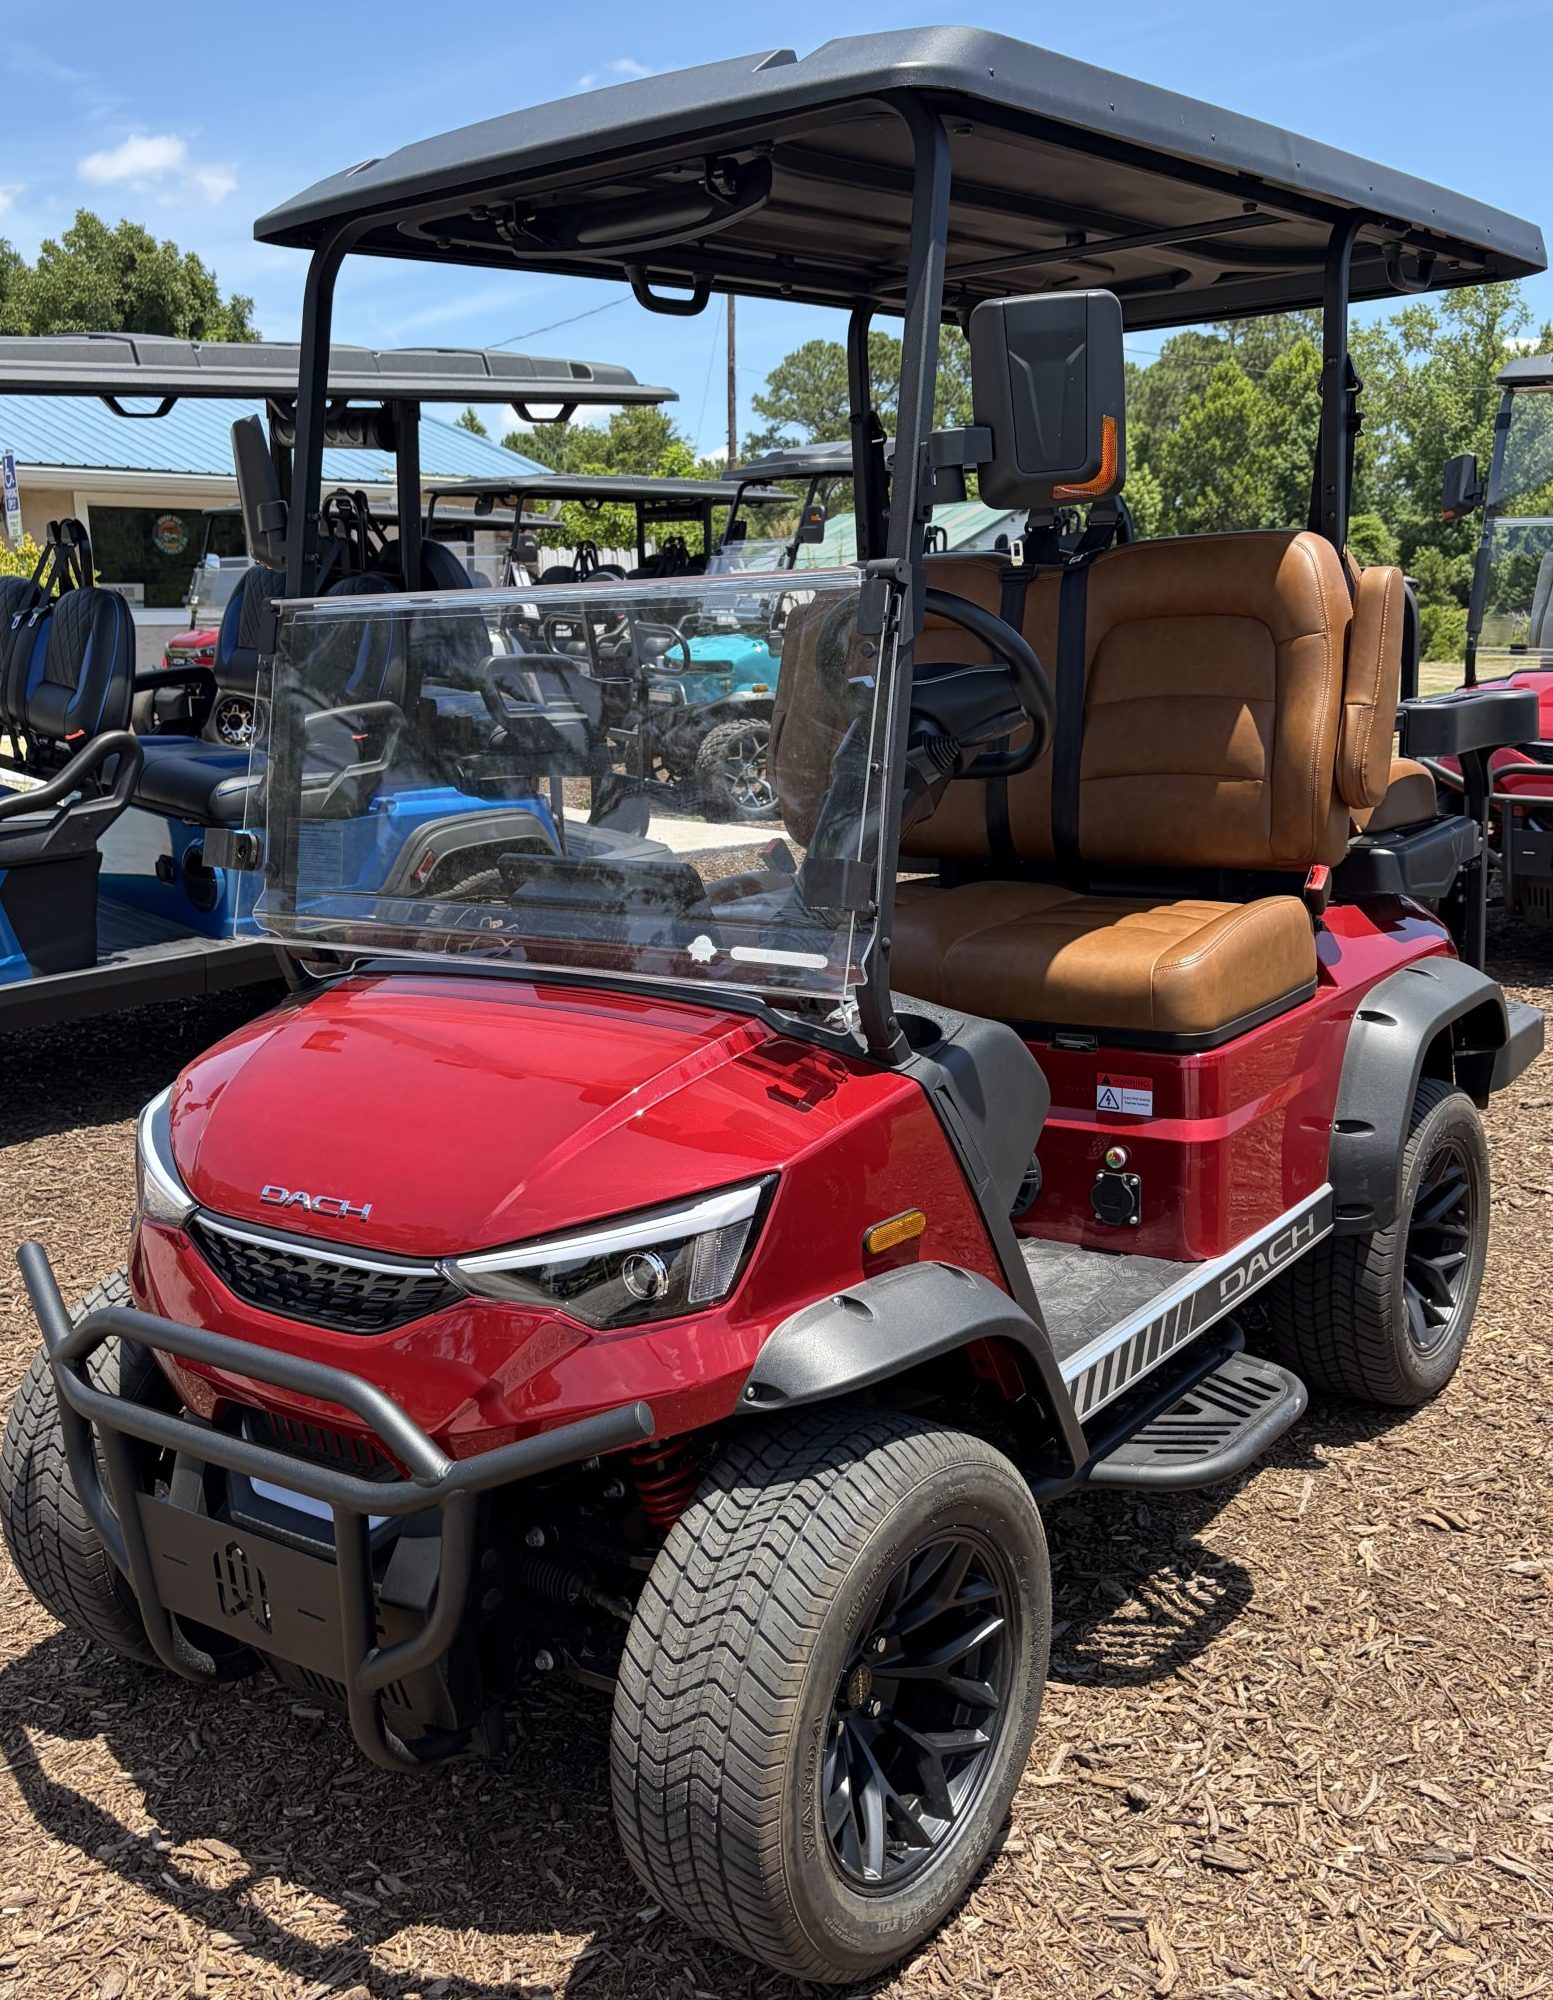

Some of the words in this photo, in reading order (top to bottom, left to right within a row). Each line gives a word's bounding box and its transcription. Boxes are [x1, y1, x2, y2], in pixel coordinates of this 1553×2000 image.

[1111, 1077, 1150, 1088] WARNING
[260, 1184, 373, 1222] DACH
[1220, 1212, 1315, 1304] DACH
